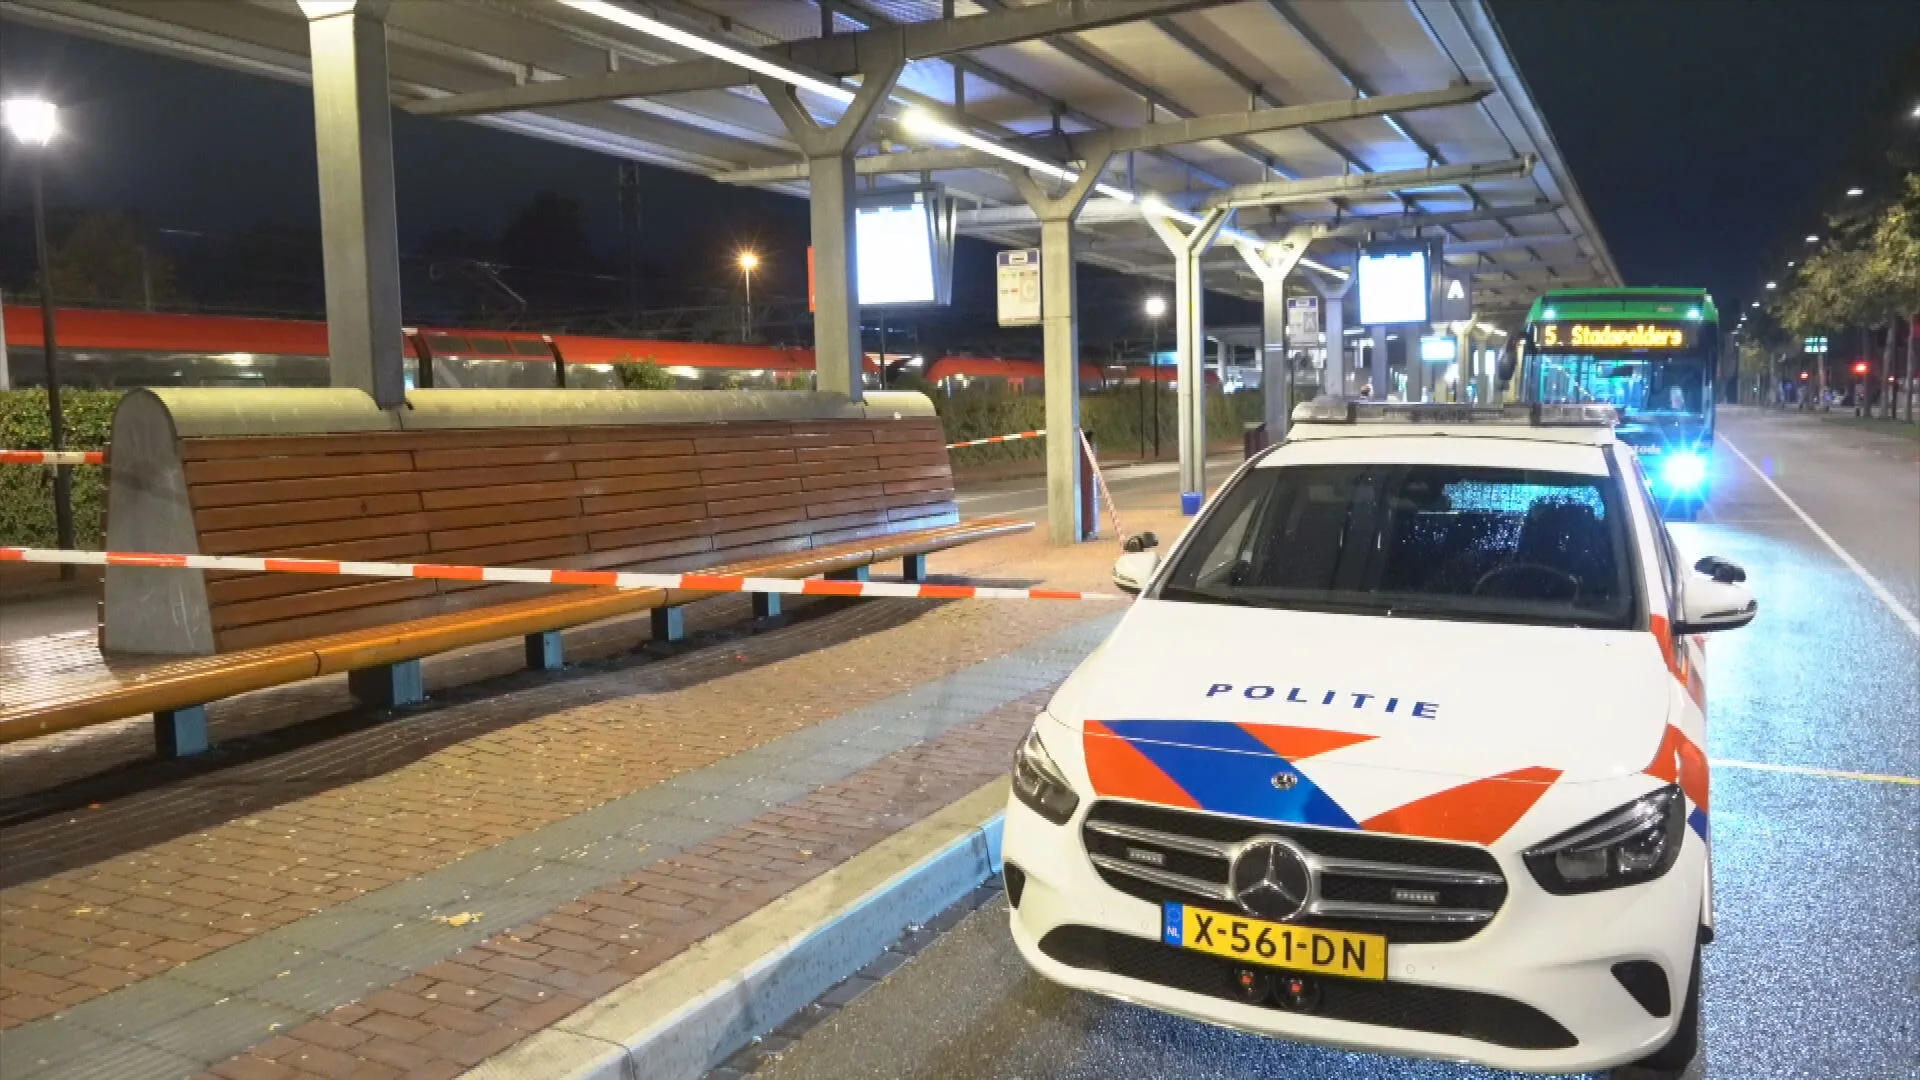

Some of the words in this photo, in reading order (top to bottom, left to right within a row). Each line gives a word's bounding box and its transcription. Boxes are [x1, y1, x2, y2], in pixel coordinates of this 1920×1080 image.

[1447, 279, 1465, 300] A
[1205, 683, 1440, 721] POLITIE
[1166, 925, 1181, 939] NL
[1194, 913, 1366, 972] X-561-DN
